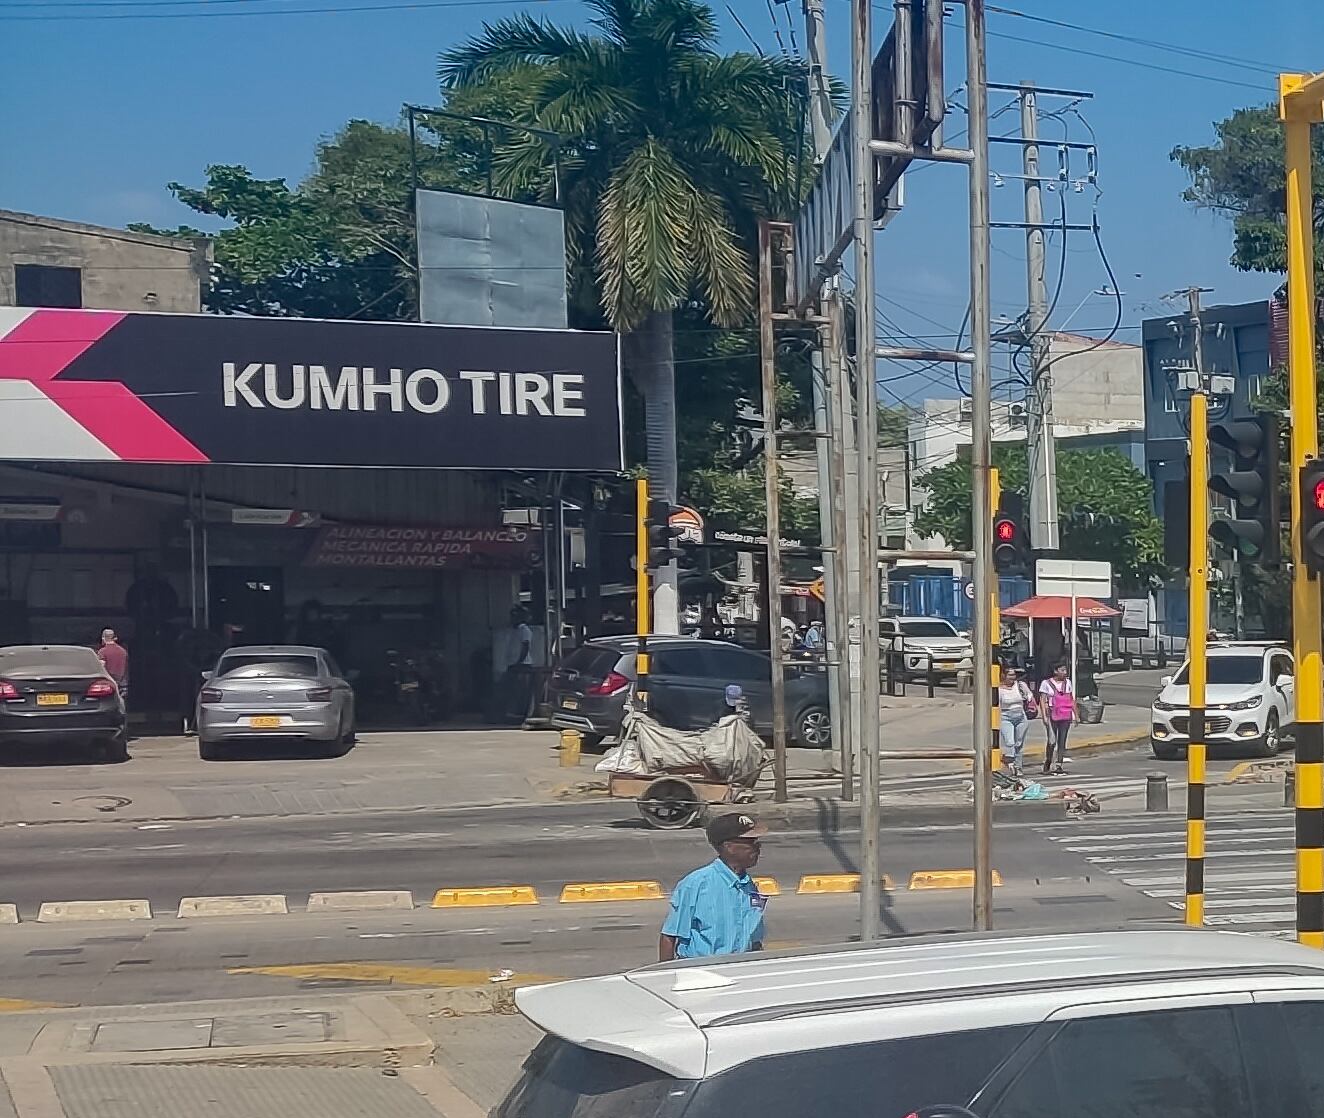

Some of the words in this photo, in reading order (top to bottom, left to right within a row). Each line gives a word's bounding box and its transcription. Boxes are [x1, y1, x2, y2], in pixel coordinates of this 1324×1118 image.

[222, 362, 450, 414] KUMHO
[459, 370, 586, 417] TIRE
[431, 531, 441, 540] Y
[411, 542, 472, 553] RAPIDA
[317, 554, 447, 566] MONTALLANTAS
